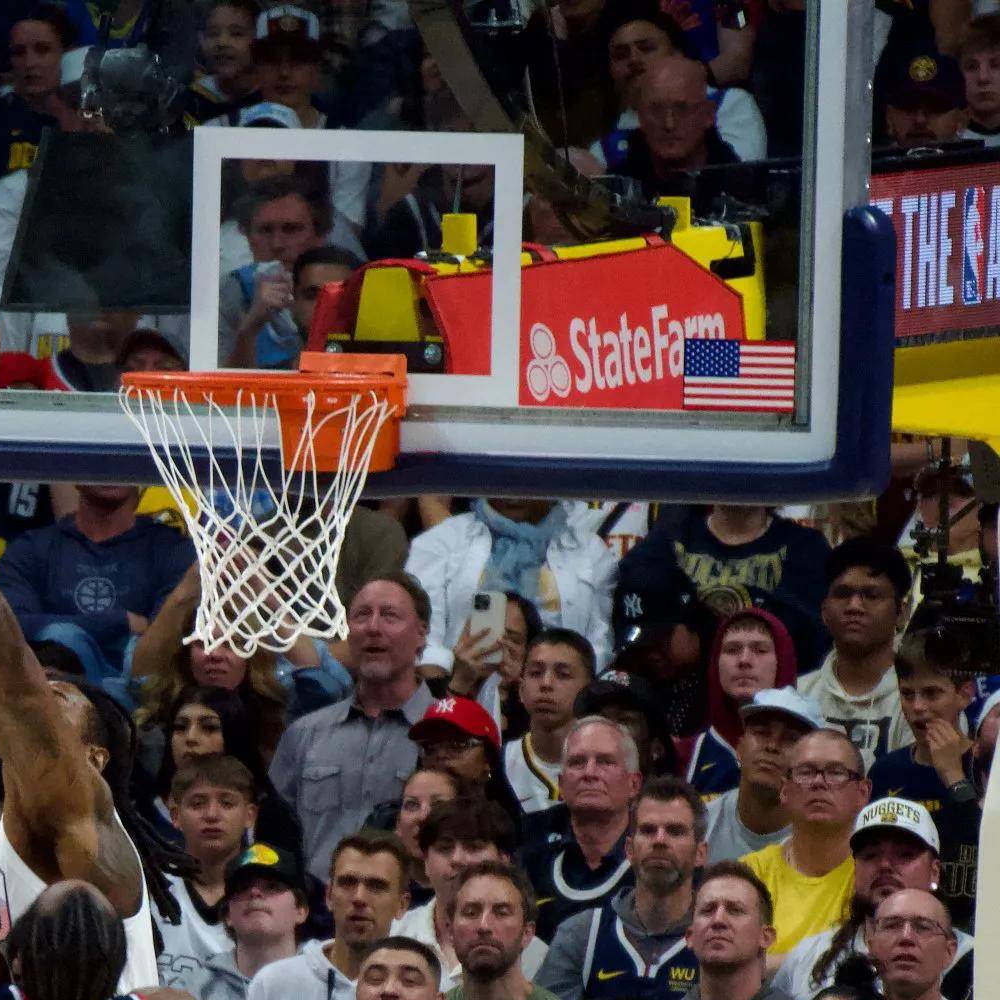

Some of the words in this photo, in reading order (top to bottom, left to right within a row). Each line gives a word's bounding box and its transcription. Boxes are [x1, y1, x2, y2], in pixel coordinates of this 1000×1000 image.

[900, 190, 956, 309] THE
[862, 801, 921, 826] NUGGETS
[670, 966, 696, 981] WU
